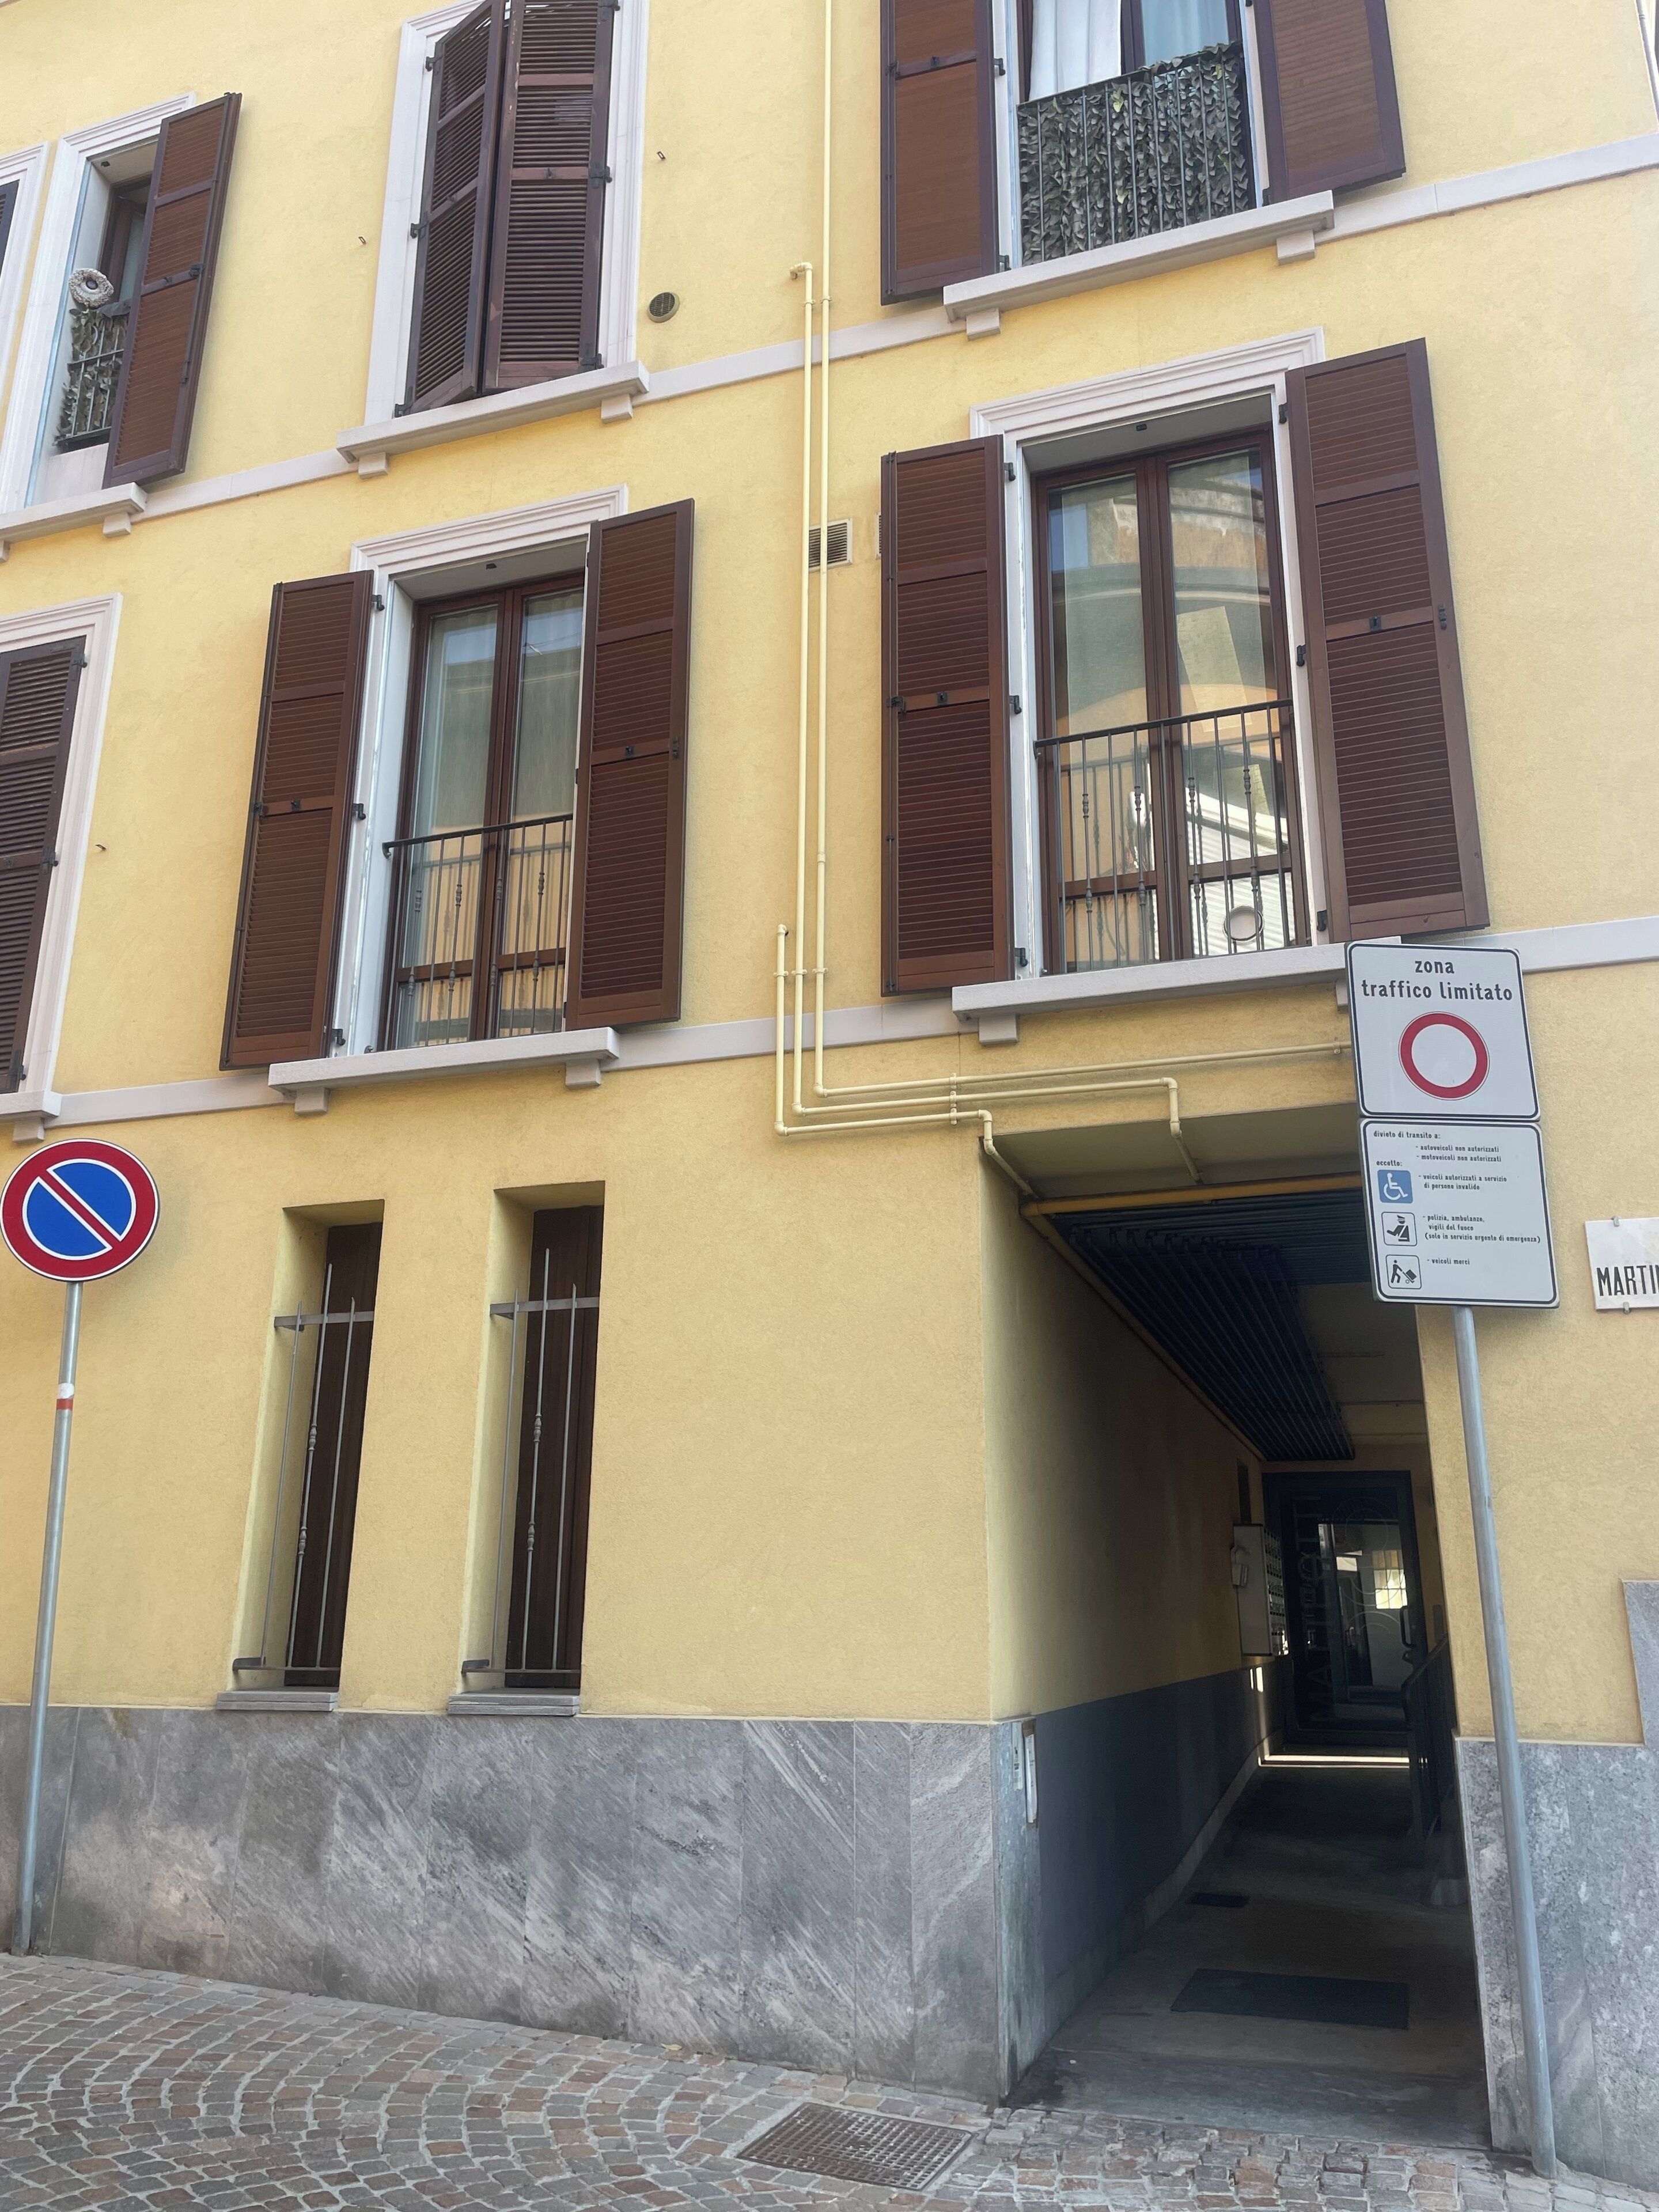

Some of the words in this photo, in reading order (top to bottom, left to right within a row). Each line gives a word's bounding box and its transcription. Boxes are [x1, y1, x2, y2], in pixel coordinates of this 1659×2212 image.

[1414, 960, 1455, 974] zona
[1361, 979, 1432, 998] traffico
[1439, 981, 1513, 1001] limitato
[1428, 1224, 1444, 1232] vigili
[1425, 1232, 1441, 1240] (solo
[1506, 1236, 1540, 1244] emergenza)
